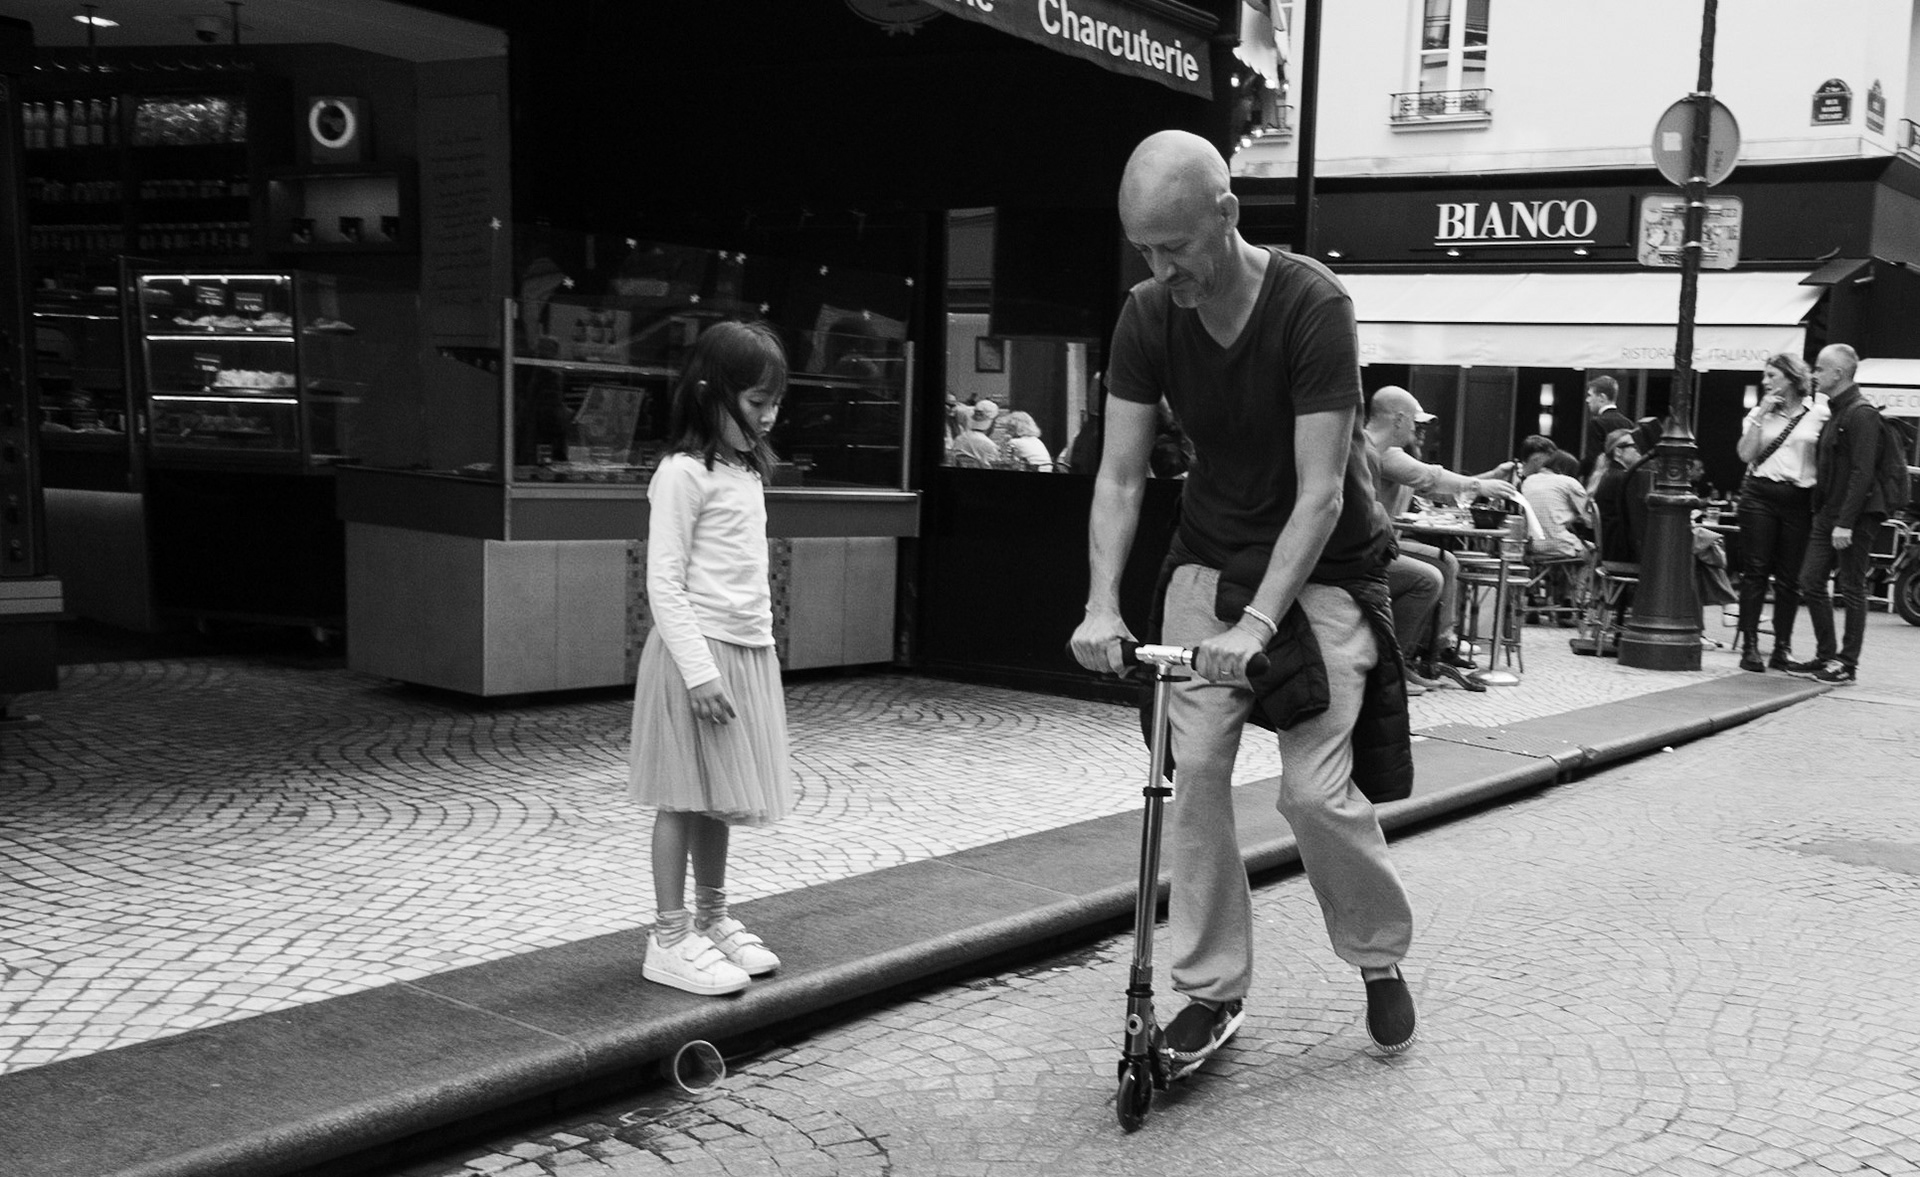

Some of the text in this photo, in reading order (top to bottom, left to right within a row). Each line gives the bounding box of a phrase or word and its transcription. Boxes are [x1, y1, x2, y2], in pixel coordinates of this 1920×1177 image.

[1037, 0, 1200, 82] Charcuterie
[1434, 199, 1598, 239] BIANCO
[1622, 347, 1771, 361] RISTORAE ITALIANO
